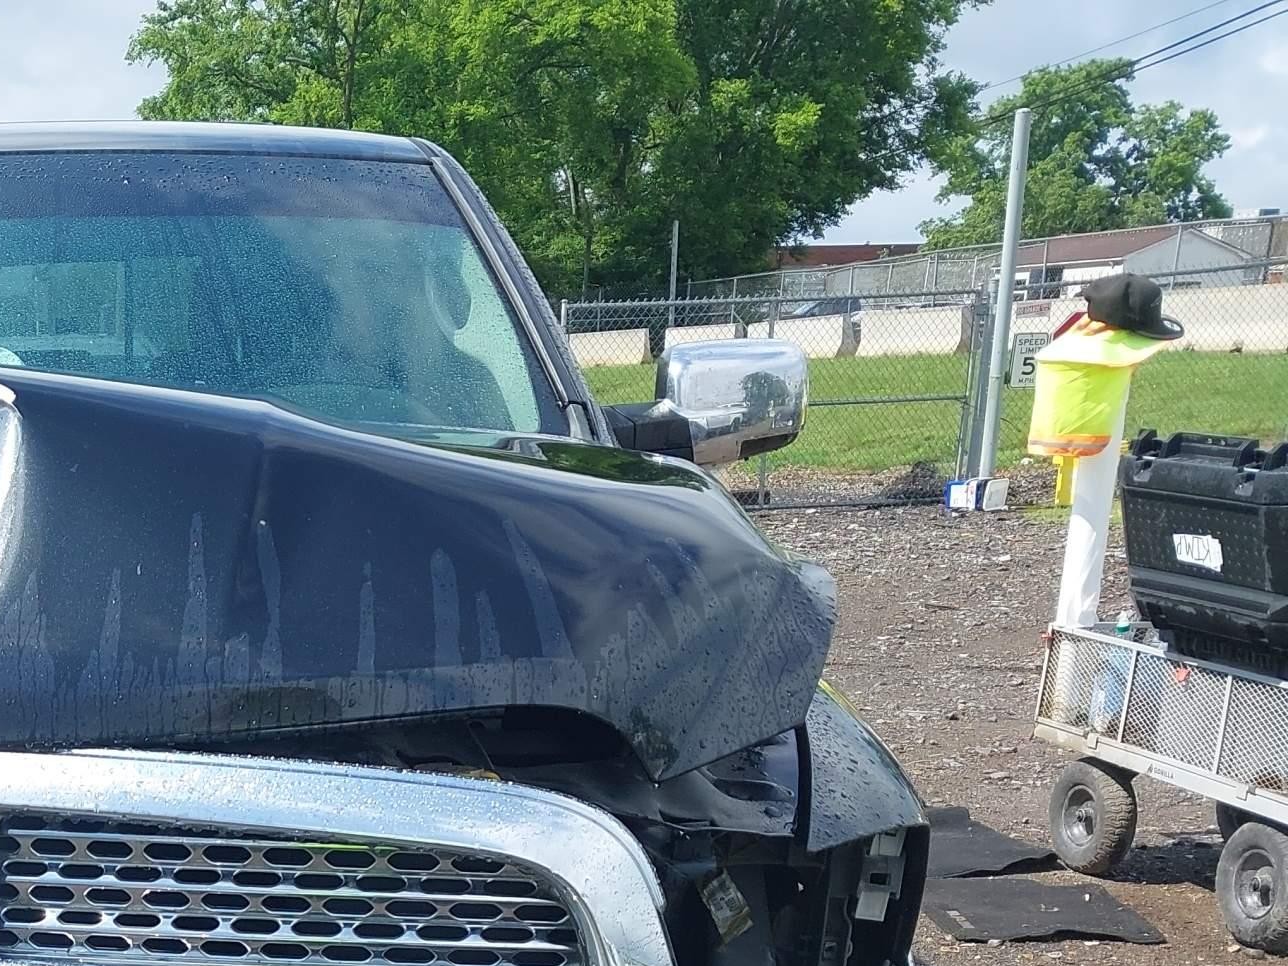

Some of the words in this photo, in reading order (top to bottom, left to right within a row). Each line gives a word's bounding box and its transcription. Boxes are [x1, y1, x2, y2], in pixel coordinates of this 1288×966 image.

[1018, 338, 1046, 346] SPEED
[1020, 346, 1041, 354] LIMIT
[1021, 357, 1035, 375] 5
